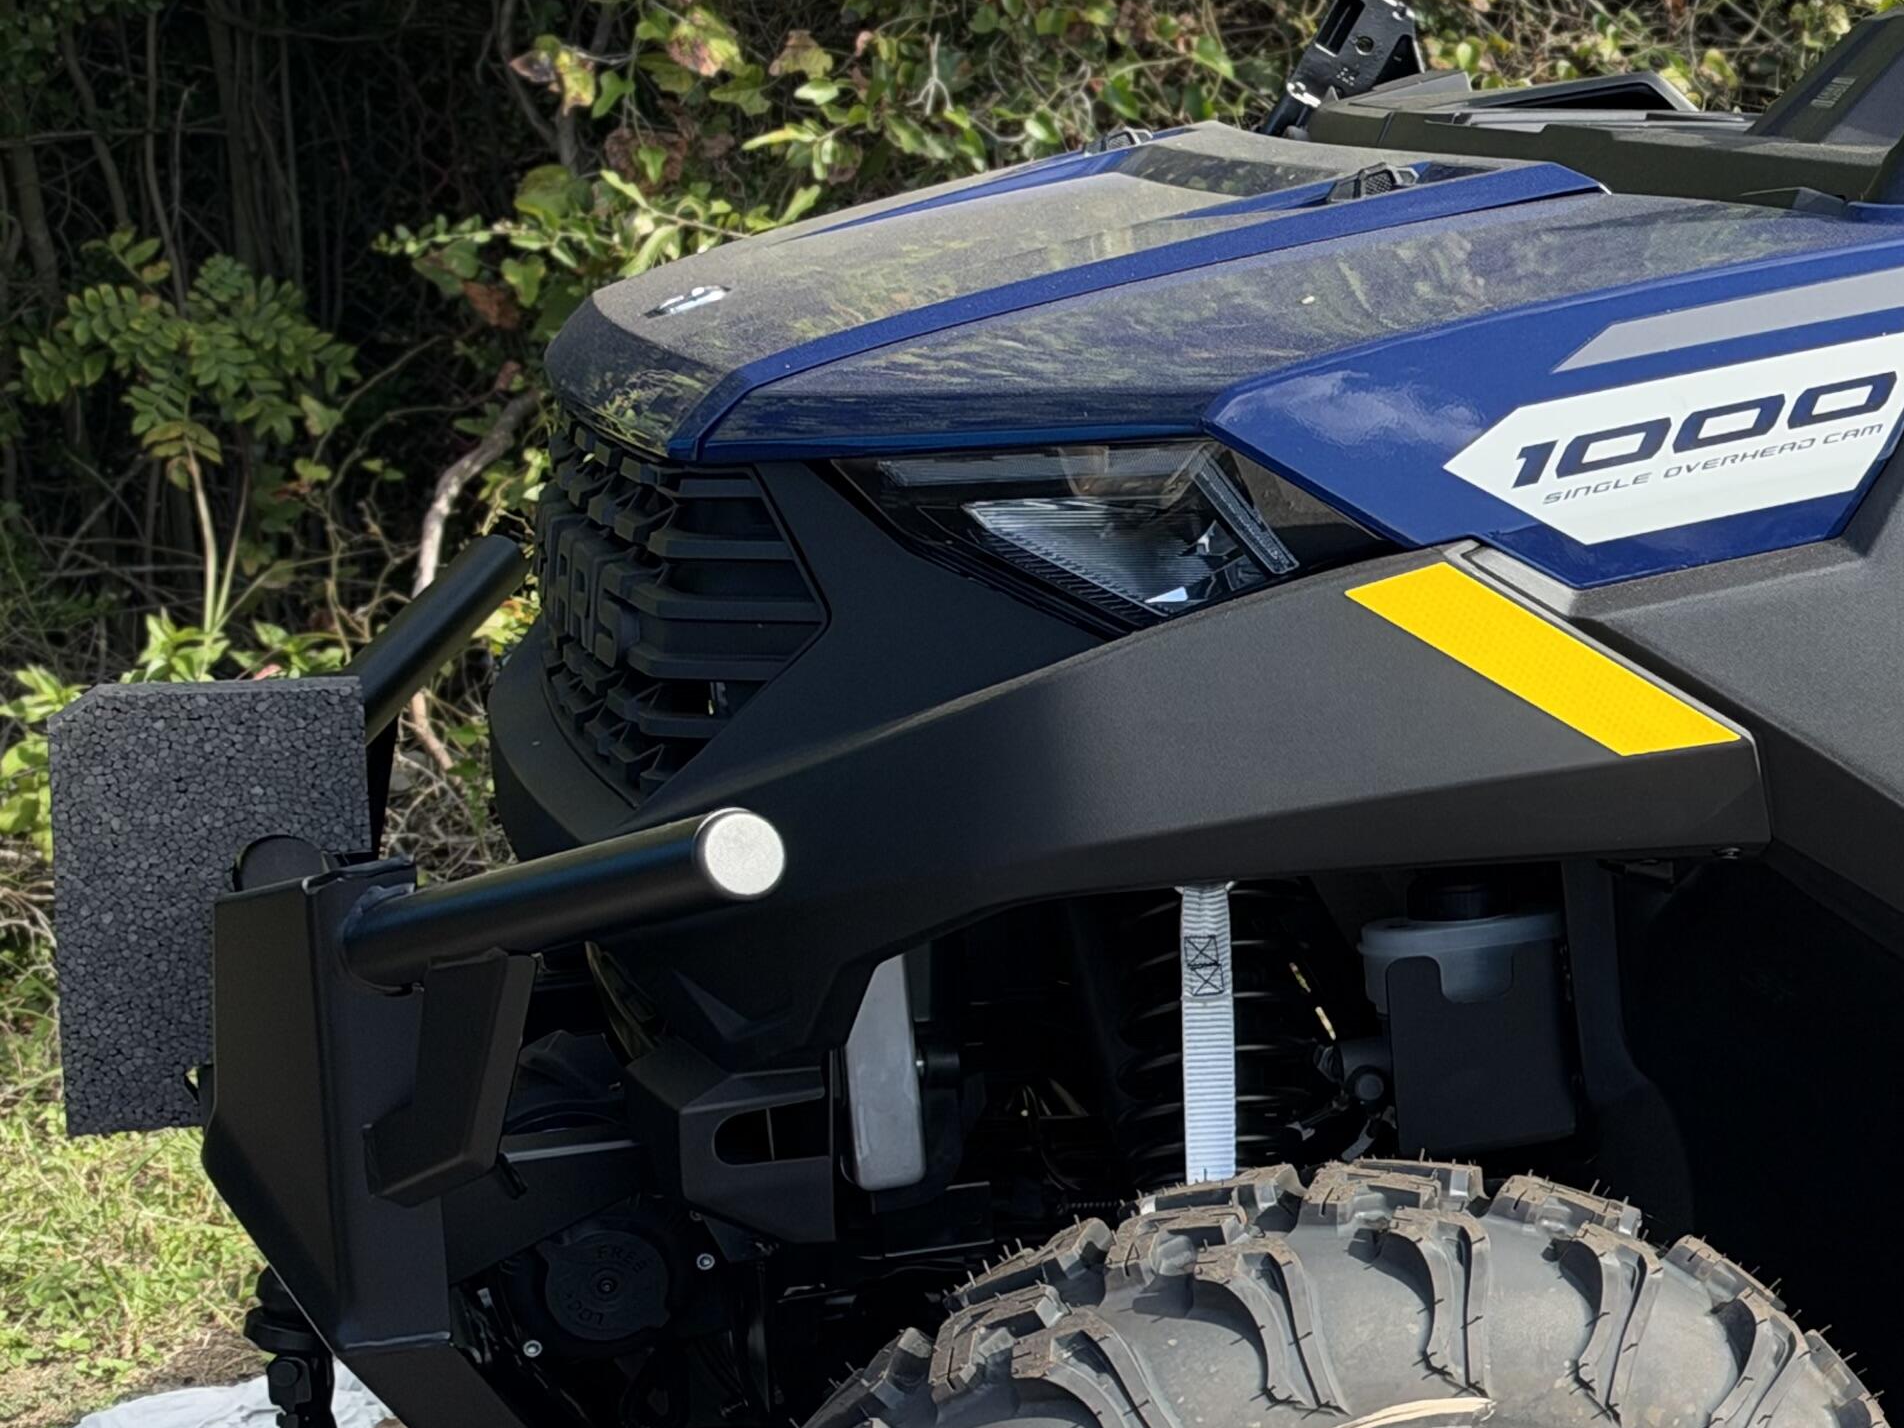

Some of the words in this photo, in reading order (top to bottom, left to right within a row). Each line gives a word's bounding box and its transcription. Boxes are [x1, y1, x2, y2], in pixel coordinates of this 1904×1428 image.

[1511, 370, 1898, 489] 1000
[1542, 471, 1653, 505] SINGLE
[1664, 437, 1817, 478] OVERHEAD
[1822, 423, 1883, 446] CAM
